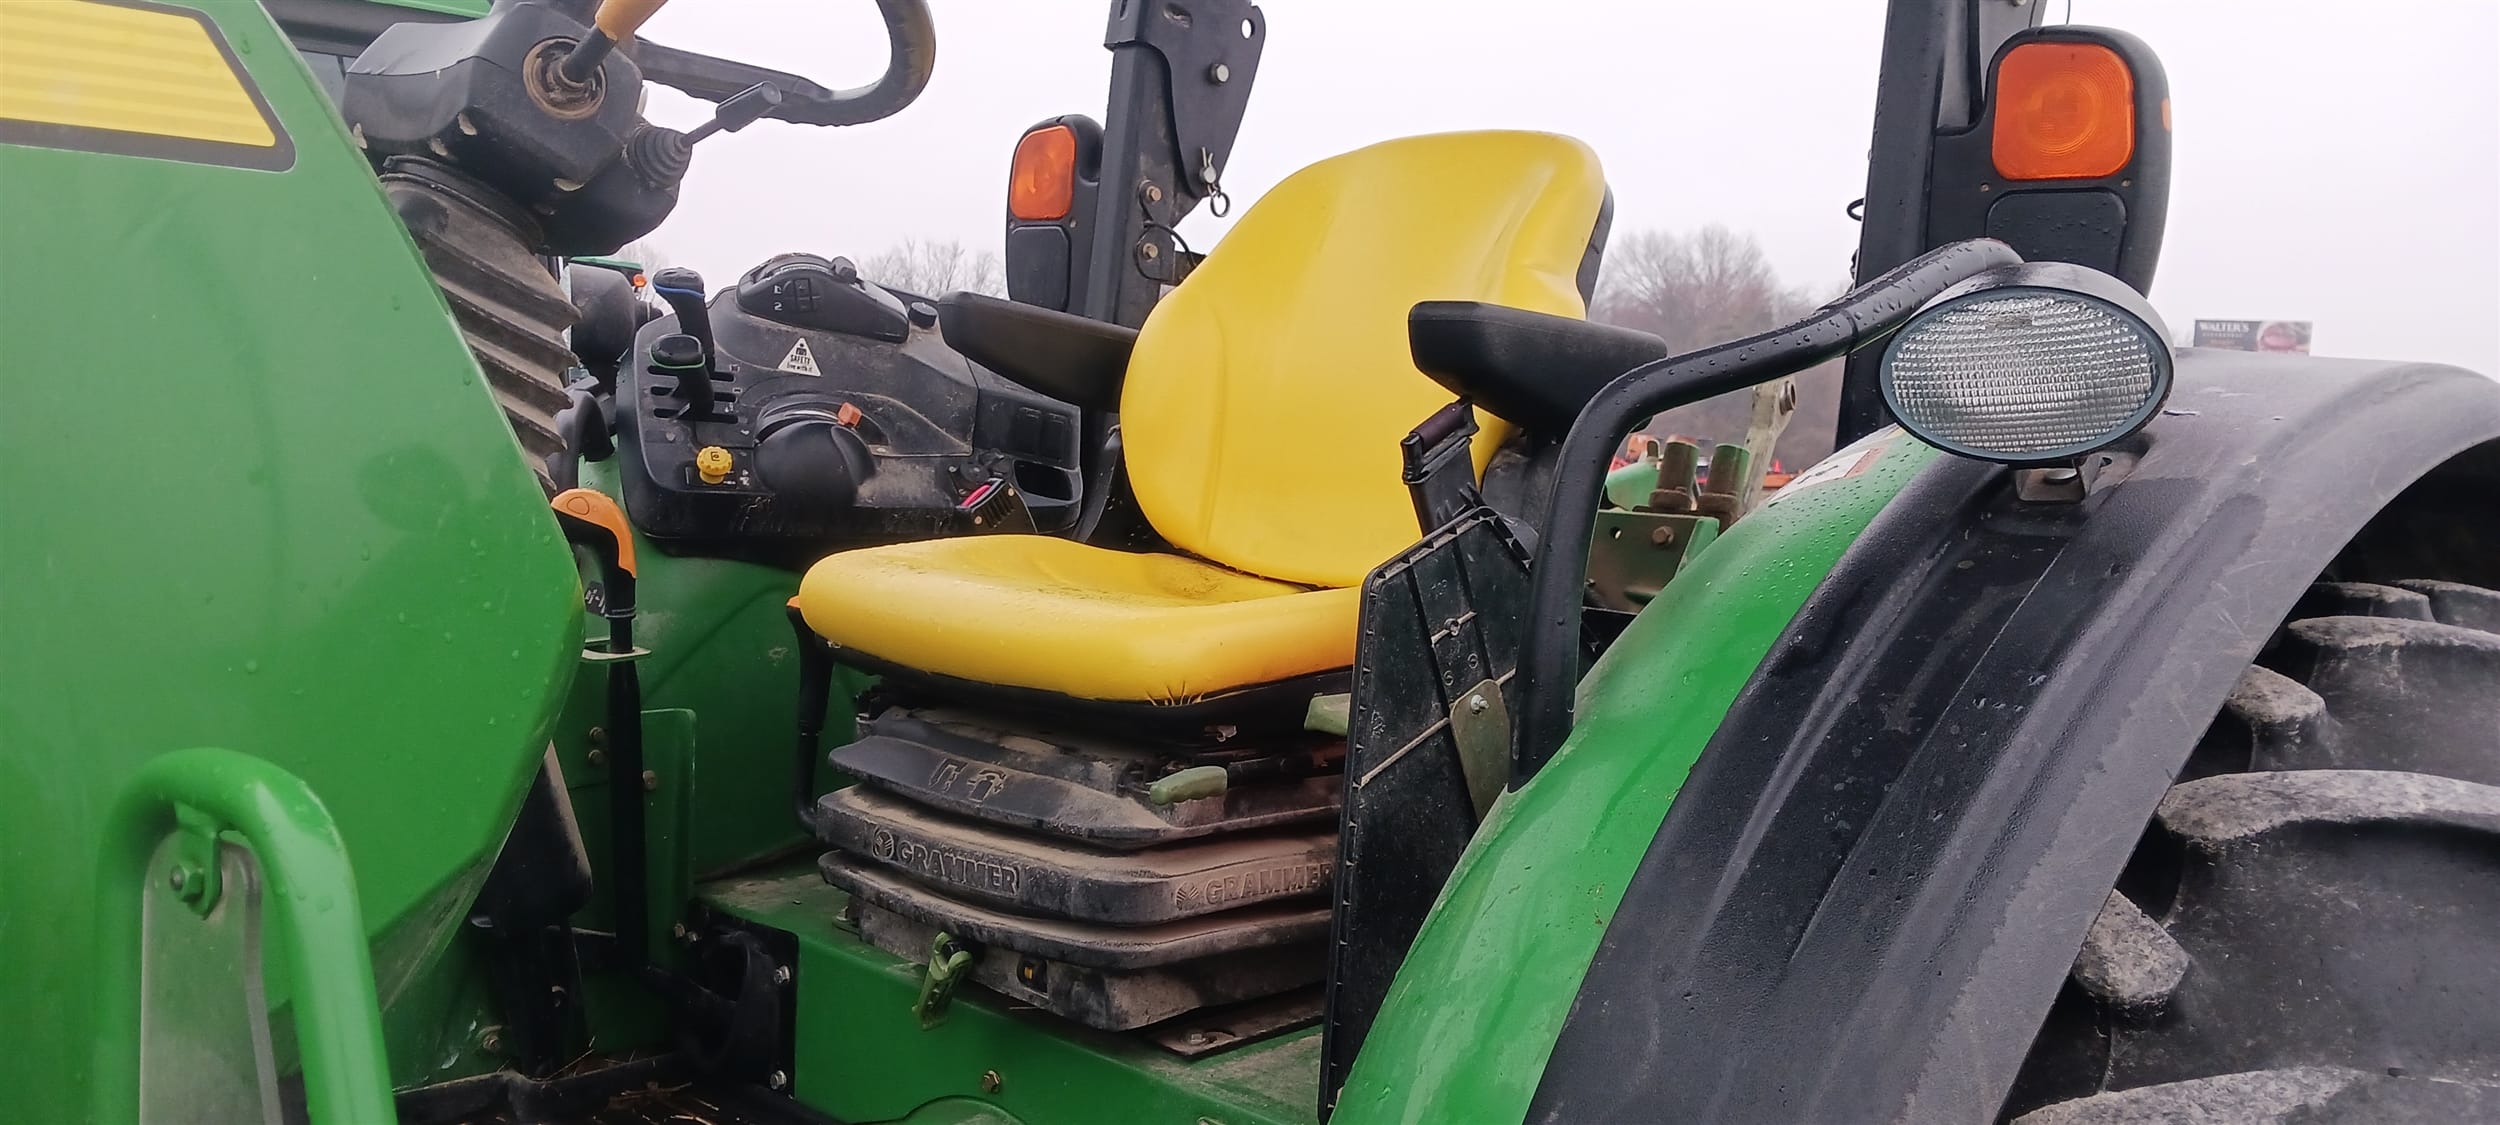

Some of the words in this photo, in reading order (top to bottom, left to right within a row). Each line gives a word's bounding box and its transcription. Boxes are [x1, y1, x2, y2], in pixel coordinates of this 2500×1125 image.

[774, 301, 783, 311] 2
[2199, 322, 2249, 333] WALTER'S
[790, 354, 811, 365] SAFETY
[897, 840, 1018, 897] GRAMMER
[1204, 862, 1336, 904] GRAMMER
